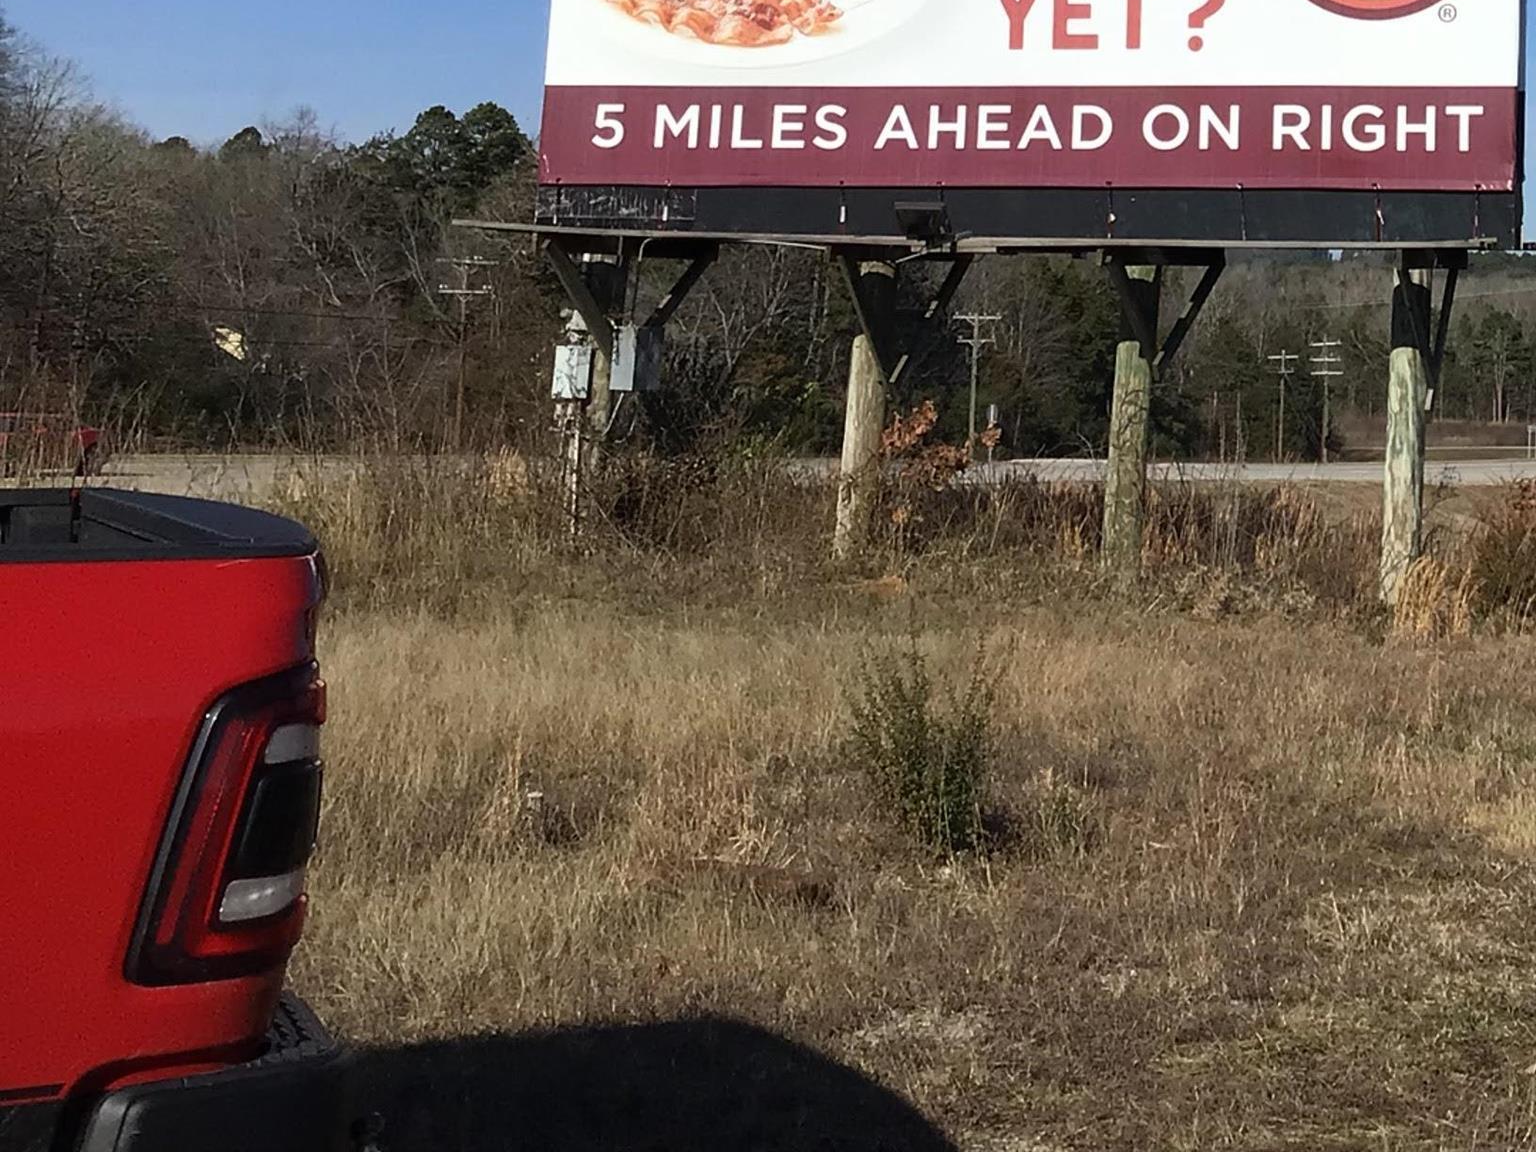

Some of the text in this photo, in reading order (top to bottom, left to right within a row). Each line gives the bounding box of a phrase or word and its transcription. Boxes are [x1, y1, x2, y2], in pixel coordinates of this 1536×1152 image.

[591, 103, 1484, 152] 5 MILES AHEAD ON RIGHT
